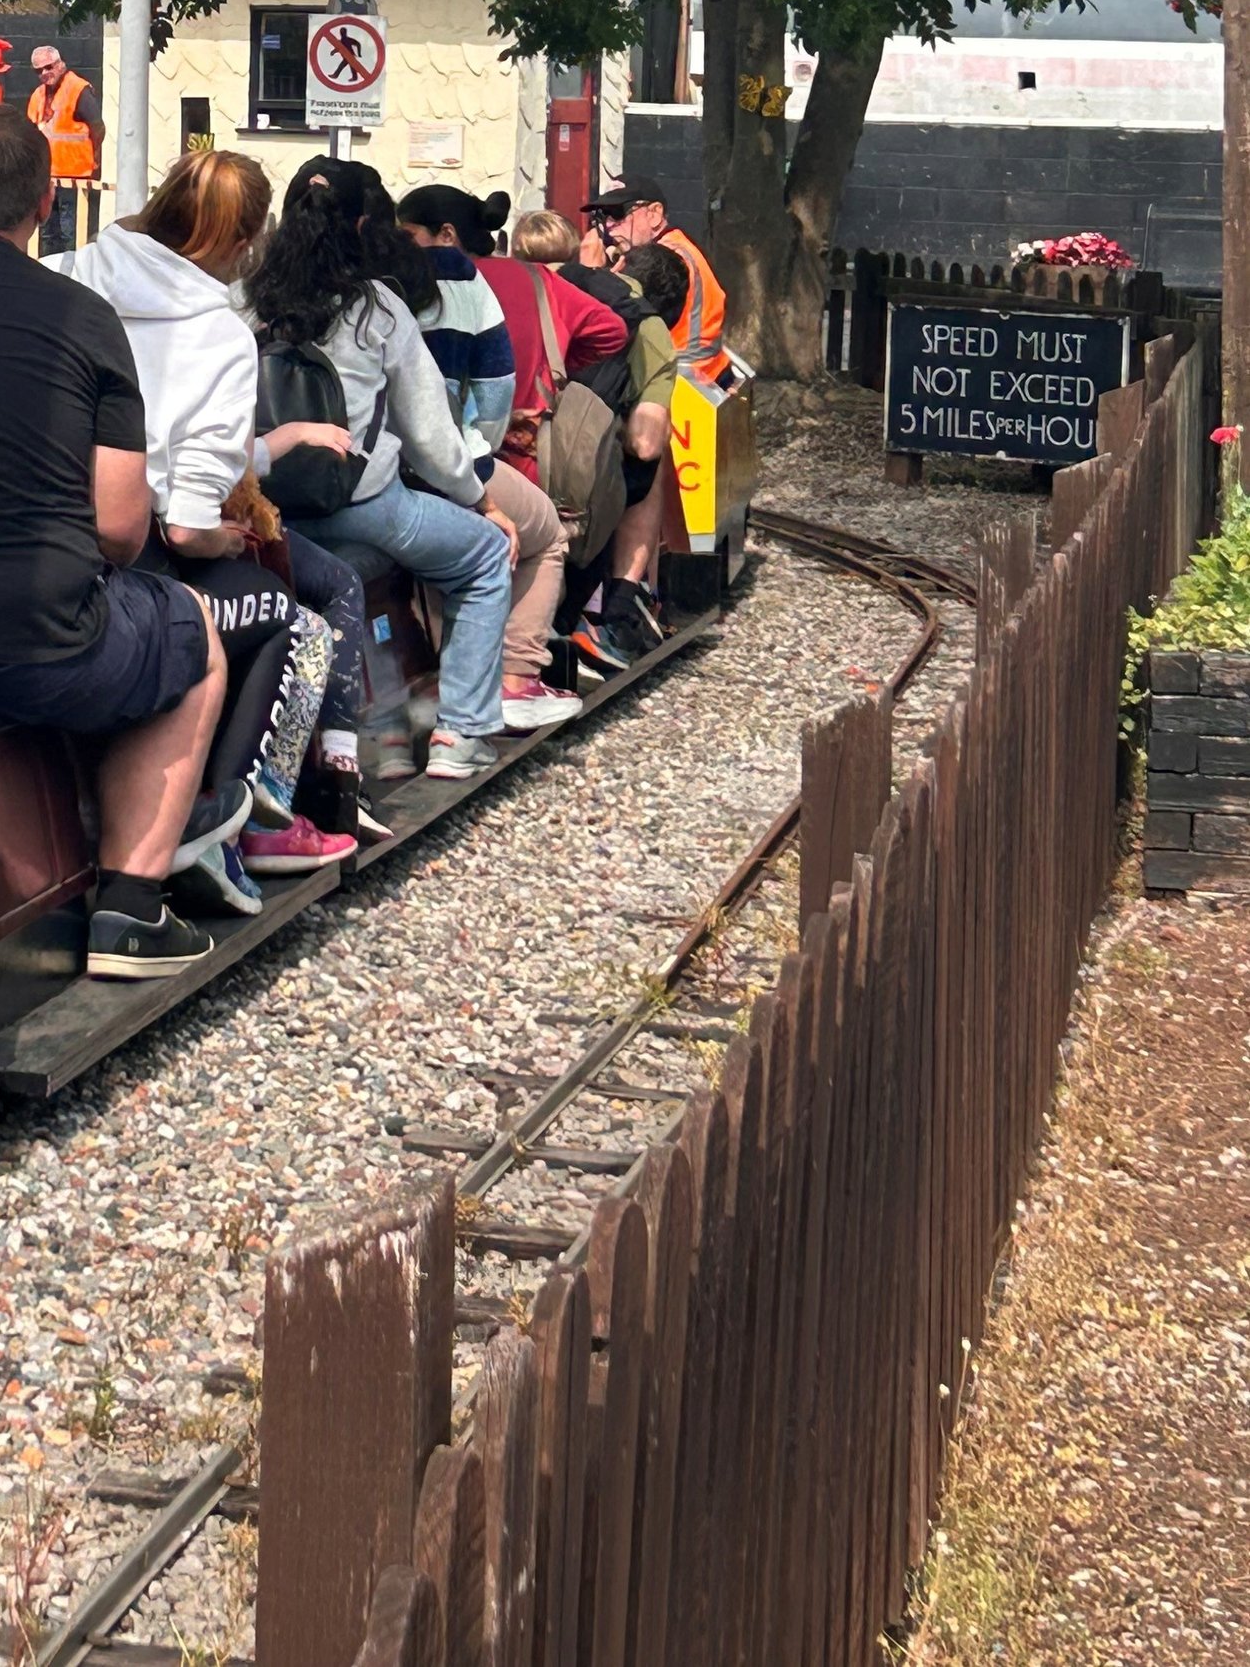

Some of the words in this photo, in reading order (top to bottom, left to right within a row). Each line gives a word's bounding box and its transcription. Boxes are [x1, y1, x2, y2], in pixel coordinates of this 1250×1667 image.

[921, 324, 998, 358] SPEED
[1016, 330, 1087, 364] MUST
[912, 365, 972, 398] NOT
[990, 370, 1095, 407] EXCEED
[900, 403, 917, 434] 5
[922, 406, 997, 441] MILES
[996, 416, 1026, 436] PER
[1026, 413, 1094, 449] HOU
